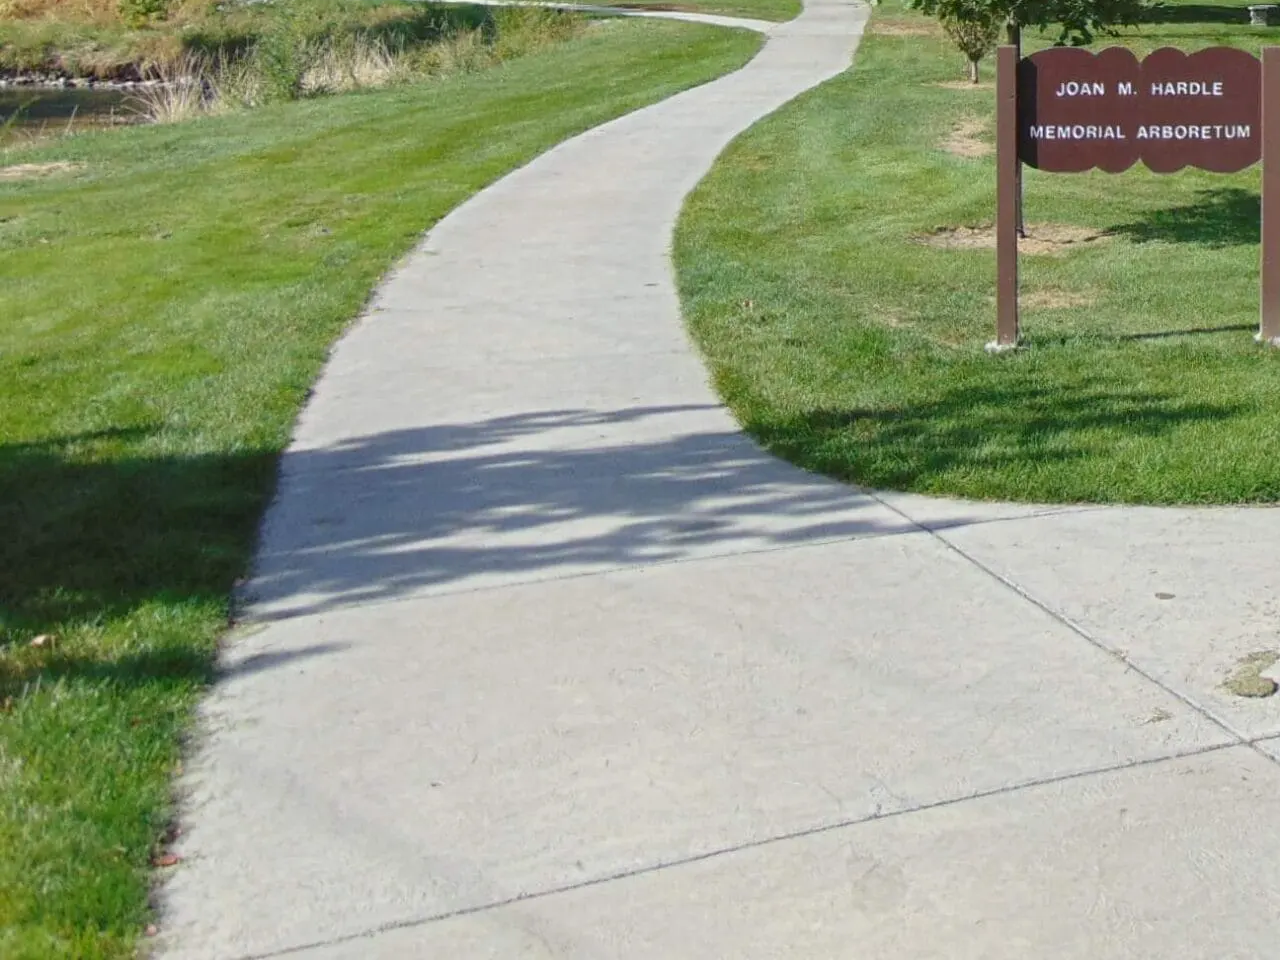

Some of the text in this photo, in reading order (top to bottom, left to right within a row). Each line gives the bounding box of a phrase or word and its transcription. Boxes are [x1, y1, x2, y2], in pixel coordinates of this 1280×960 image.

[1056, 82, 1224, 97] JOAN M. HARDLE
[1030, 125, 1251, 139] MEMORIAL ARBORETUM
